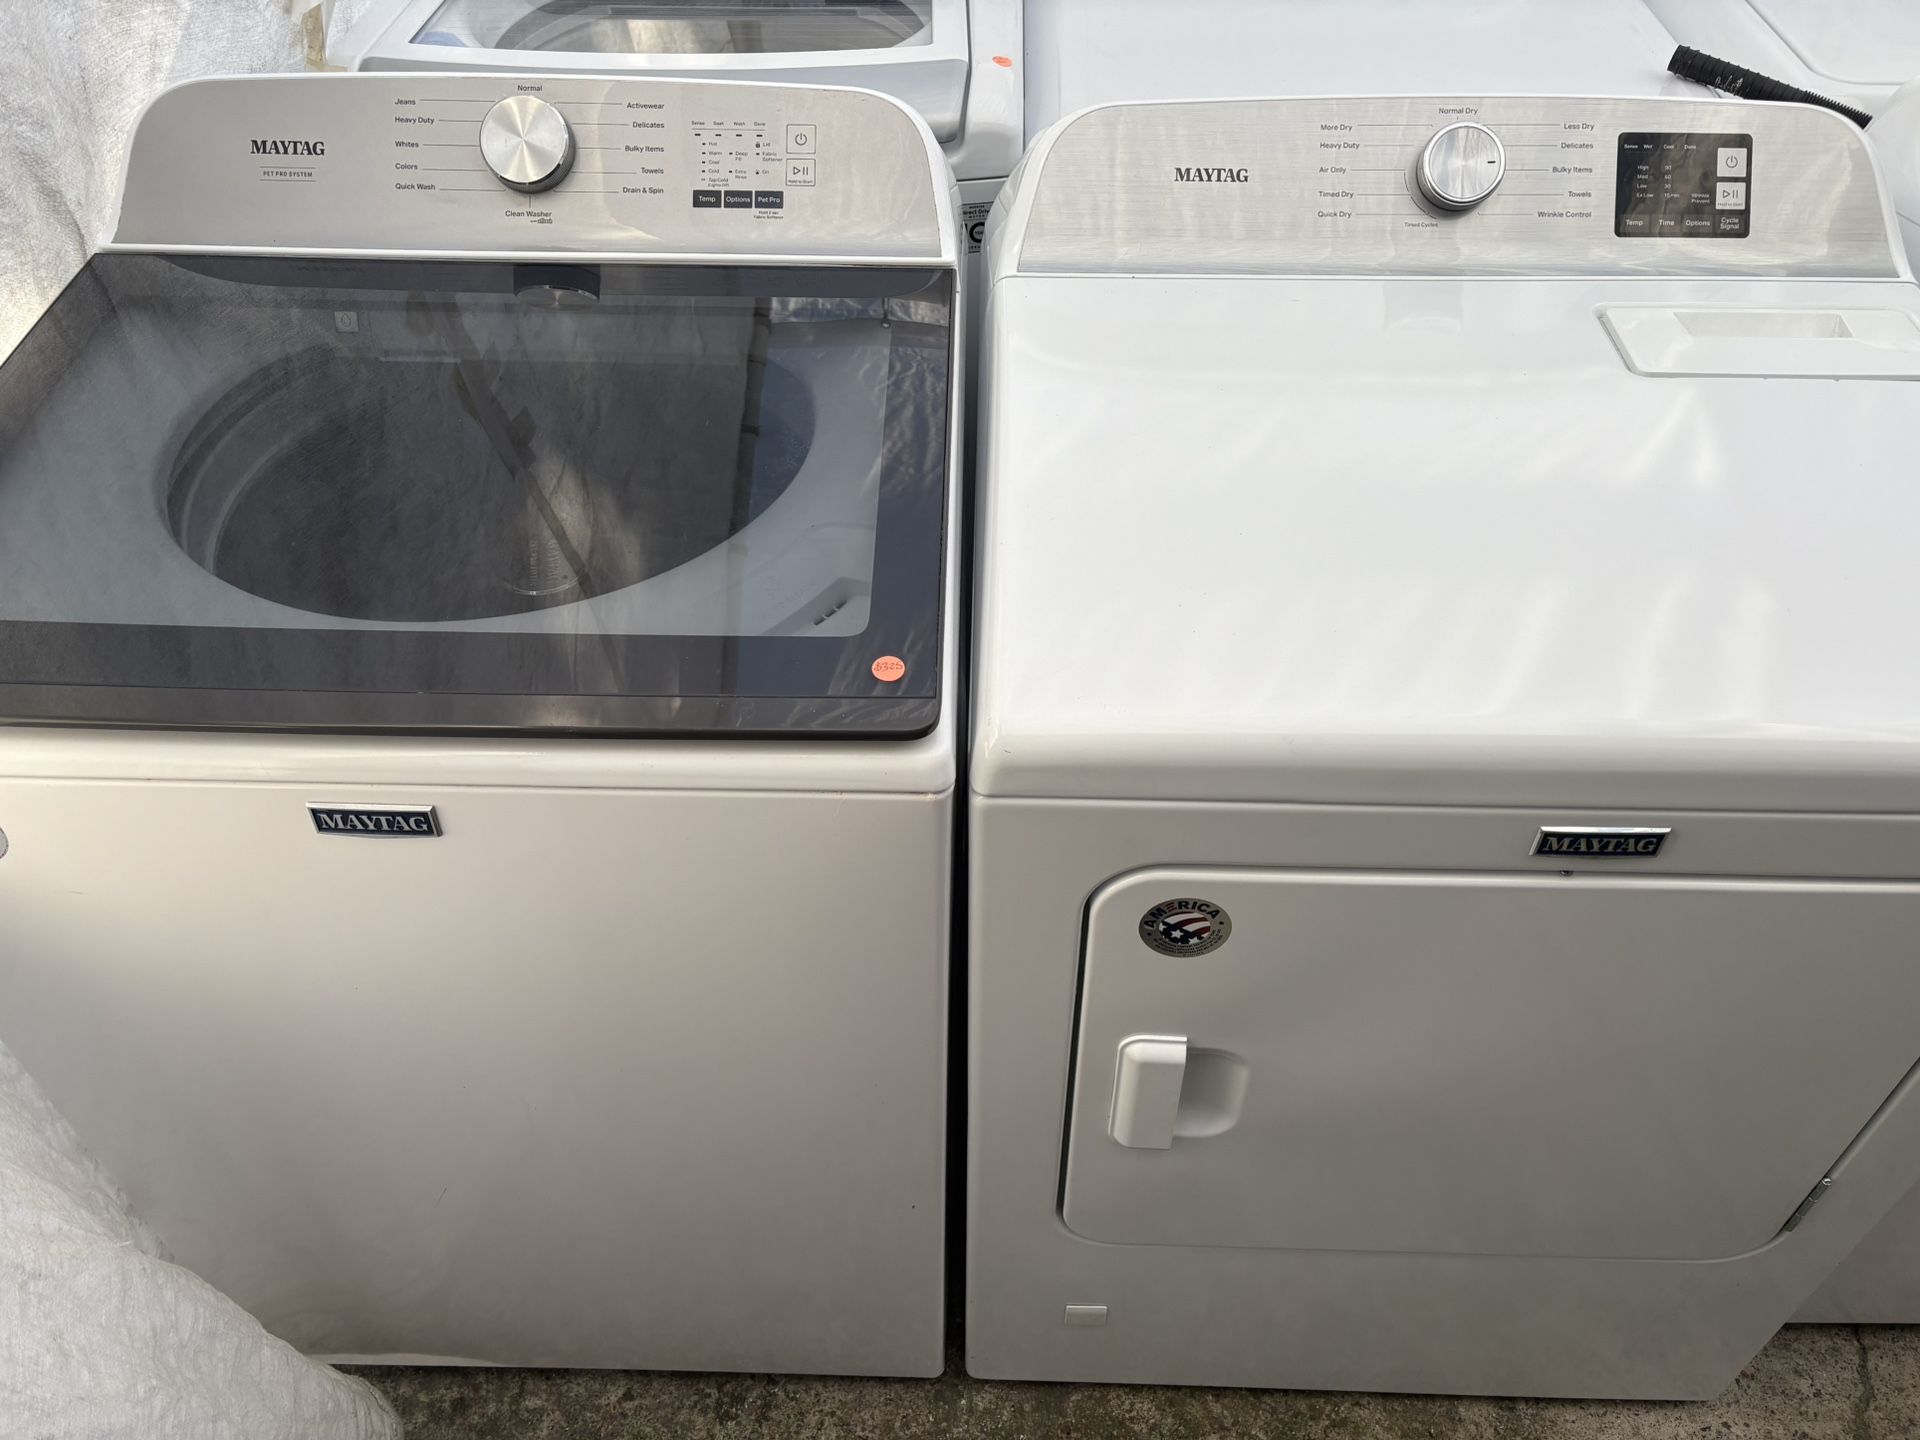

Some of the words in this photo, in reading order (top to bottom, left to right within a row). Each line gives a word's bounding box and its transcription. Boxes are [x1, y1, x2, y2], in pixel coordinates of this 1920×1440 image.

[517, 84, 544, 92] Normal
[394, 98, 417, 106] Jeans
[626, 102, 665, 110] Activewear
[1438, 106, 1463, 115] Normal
[1465, 107, 1479, 117] Dry
[394, 116, 416, 126] Heavy
[417, 116, 435, 126] Duty
[632, 121, 665, 130] Delicates
[1320, 123, 1339, 131] More
[1340, 123, 1354, 133] Dry
[1581, 123, 1596, 132] Dry
[250, 139, 326, 156] MAYTAG
[394, 140, 420, 148] Whites
[1319, 141, 1342, 151] Heavy
[1342, 142, 1361, 151] Duty
[1561, 142, 1595, 150] Delicates
[624, 145, 644, 154] Bulky
[645, 145, 665, 153] Items
[394, 162, 419, 170] Colors
[1551, 166, 1572, 175] Bulky
[1573, 166, 1593, 174] Items
[640, 167, 665, 175] Towels
[1174, 167, 1249, 183] MAYTAG
[1319, 166, 1330, 174] Air
[1330, 166, 1347, 176] Only
[394, 182, 415, 191] Quick
[416, 182, 436, 191] Wash
[622, 186, 641, 194] Drain
[648, 187, 664, 196] Spin
[1318, 190, 1340, 199] Timed
[1340, 191, 1354, 200] Dry
[1568, 190, 1592, 199] Towels
[698, 195, 717, 204] Temp
[725, 195, 751, 204] Options
[757, 196, 769, 204] Pet
[769, 196, 781, 204] Pro
[505, 210, 525, 218] Clean
[526, 210, 552, 218] Washer
[1317, 211, 1337, 220] Quick
[1338, 211, 1353, 221] Dry
[1538, 210, 1564, 219] Wrinkle
[1564, 210, 1592, 219] Control
[1626, 218, 1644, 228] Temp
[1658, 218, 1675, 226] Time
[1685, 219, 1711, 228] Options
[1720, 216, 1740, 225] Cycle
[1720, 223, 1740, 231] Signal
[316, 813, 429, 832] MAYTAG
[1542, 837, 1658, 853] MAYTAG
[1143, 900, 1221, 930] AMERICA
